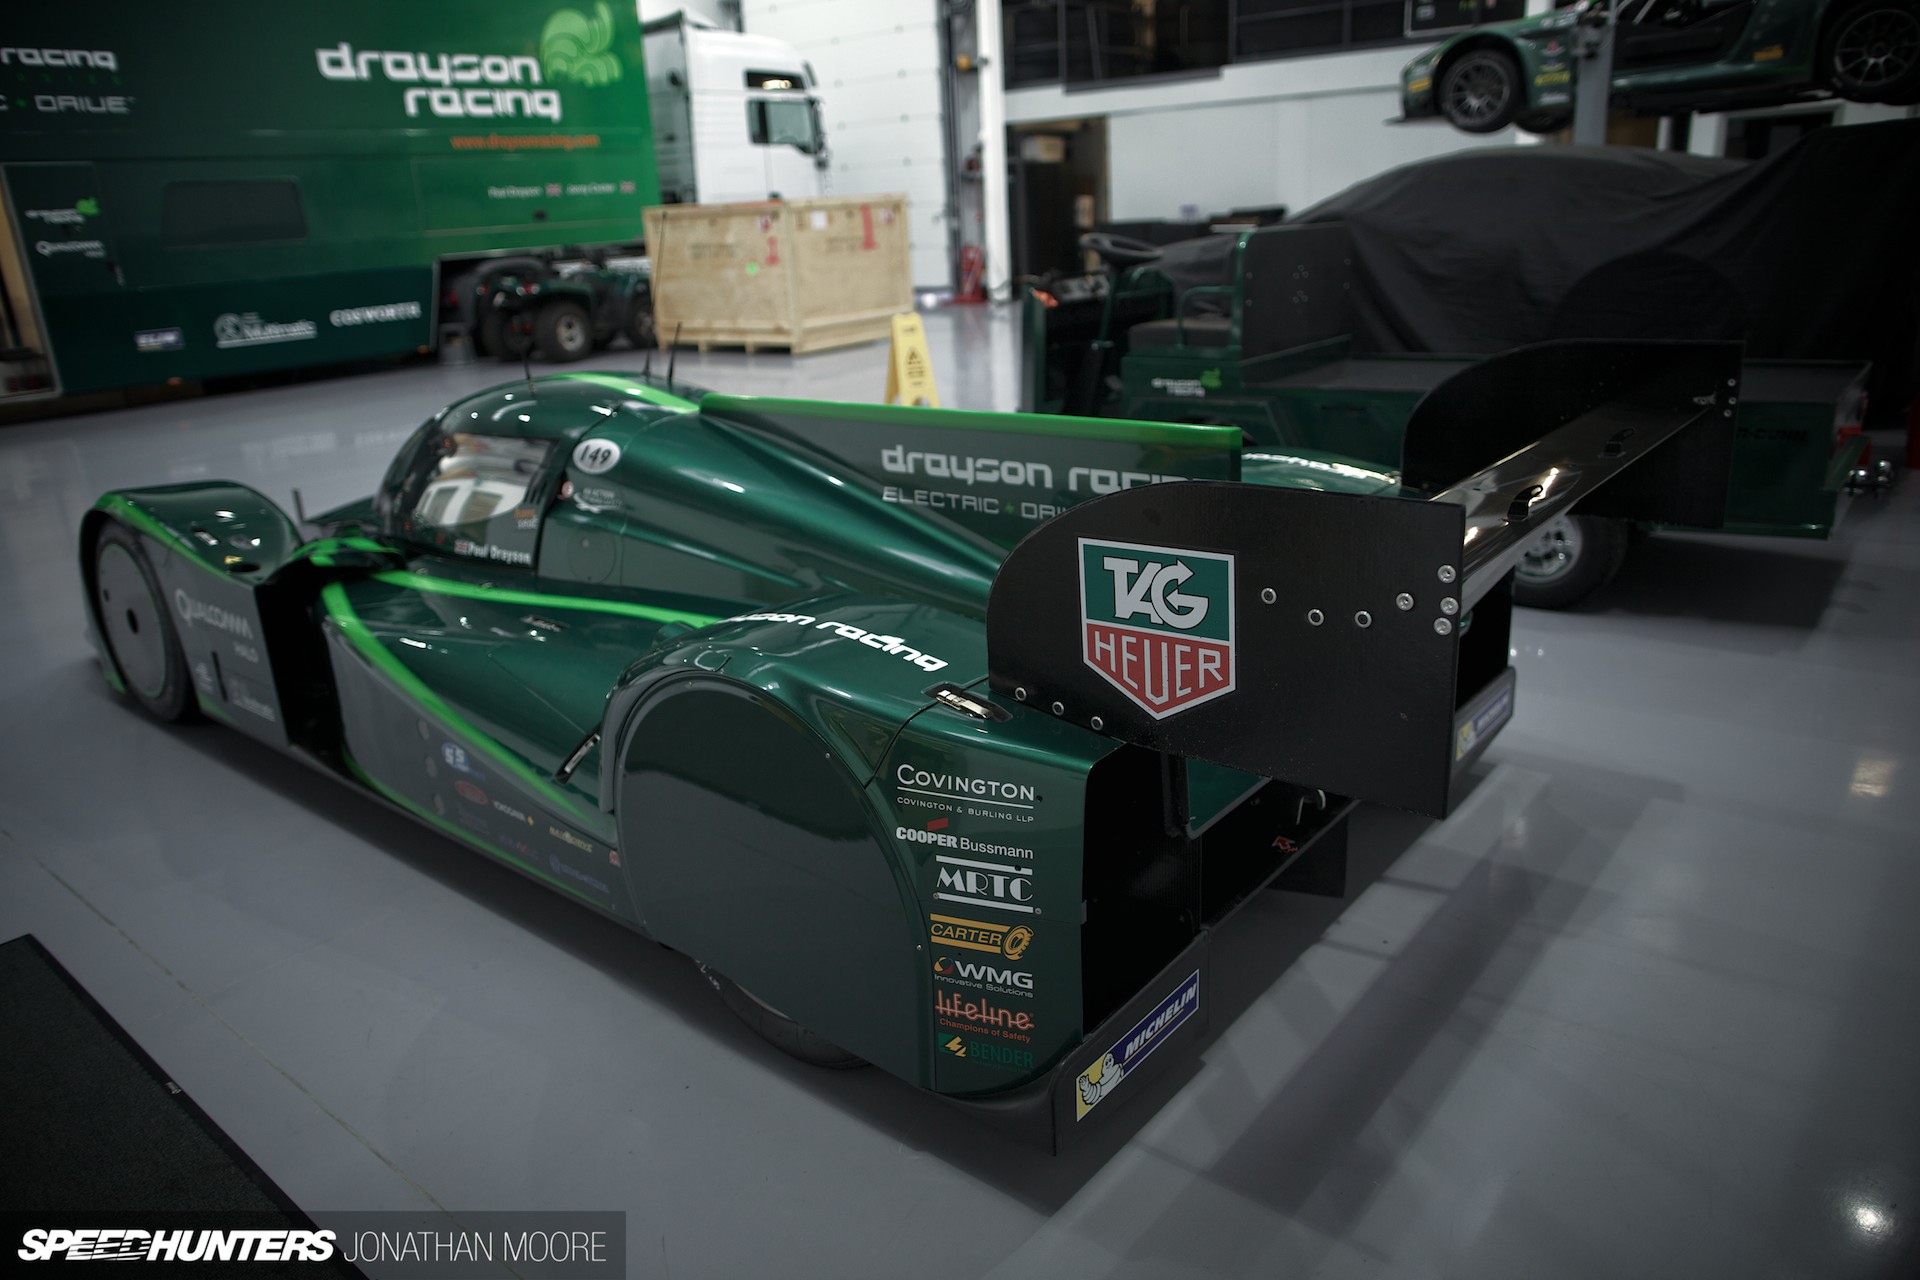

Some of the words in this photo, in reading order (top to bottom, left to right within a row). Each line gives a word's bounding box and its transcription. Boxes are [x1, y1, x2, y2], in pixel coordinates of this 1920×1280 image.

[314, 42, 541, 86] drayson
[402, 86, 562, 123] racing
[580, 445, 612, 465] 149
[881, 445, 1053, 488] drayson
[882, 486, 1000, 515] ELECTRIC
[1020, 502, 1068, 521] DRI
[467, 541, 489, 559] Paul
[490, 545, 532, 567] Drayson
[1103, 557, 1210, 630] TAG
[816, 611, 949, 672] racing
[1094, 630, 1224, 706] HEUER
[897, 763, 1035, 801] COVINGTON
[897, 797, 953, 812] COVINGTON
[956, 806, 963, 814] &
[968, 808, 1013, 821] BURLING
[1016, 815, 1034, 823] LLP
[896, 826, 958, 849] COOPER
[960, 837, 1035, 860] Bussmann
[936, 866, 1034, 902] MRTC
[930, 923, 1003, 946] CARTER
[934, 973, 983, 990] Innovative
[986, 983, 1034, 999] Solutions
[954, 960, 1034, 990] WMG
[940, 1017, 989, 1035] Champions
[991, 1028, 1001, 1037] of
[1002, 1029, 1032, 1044] Safety
[1123, 982, 1198, 1061] MICHELIN
[969, 1040, 1035, 1070] BENDER
